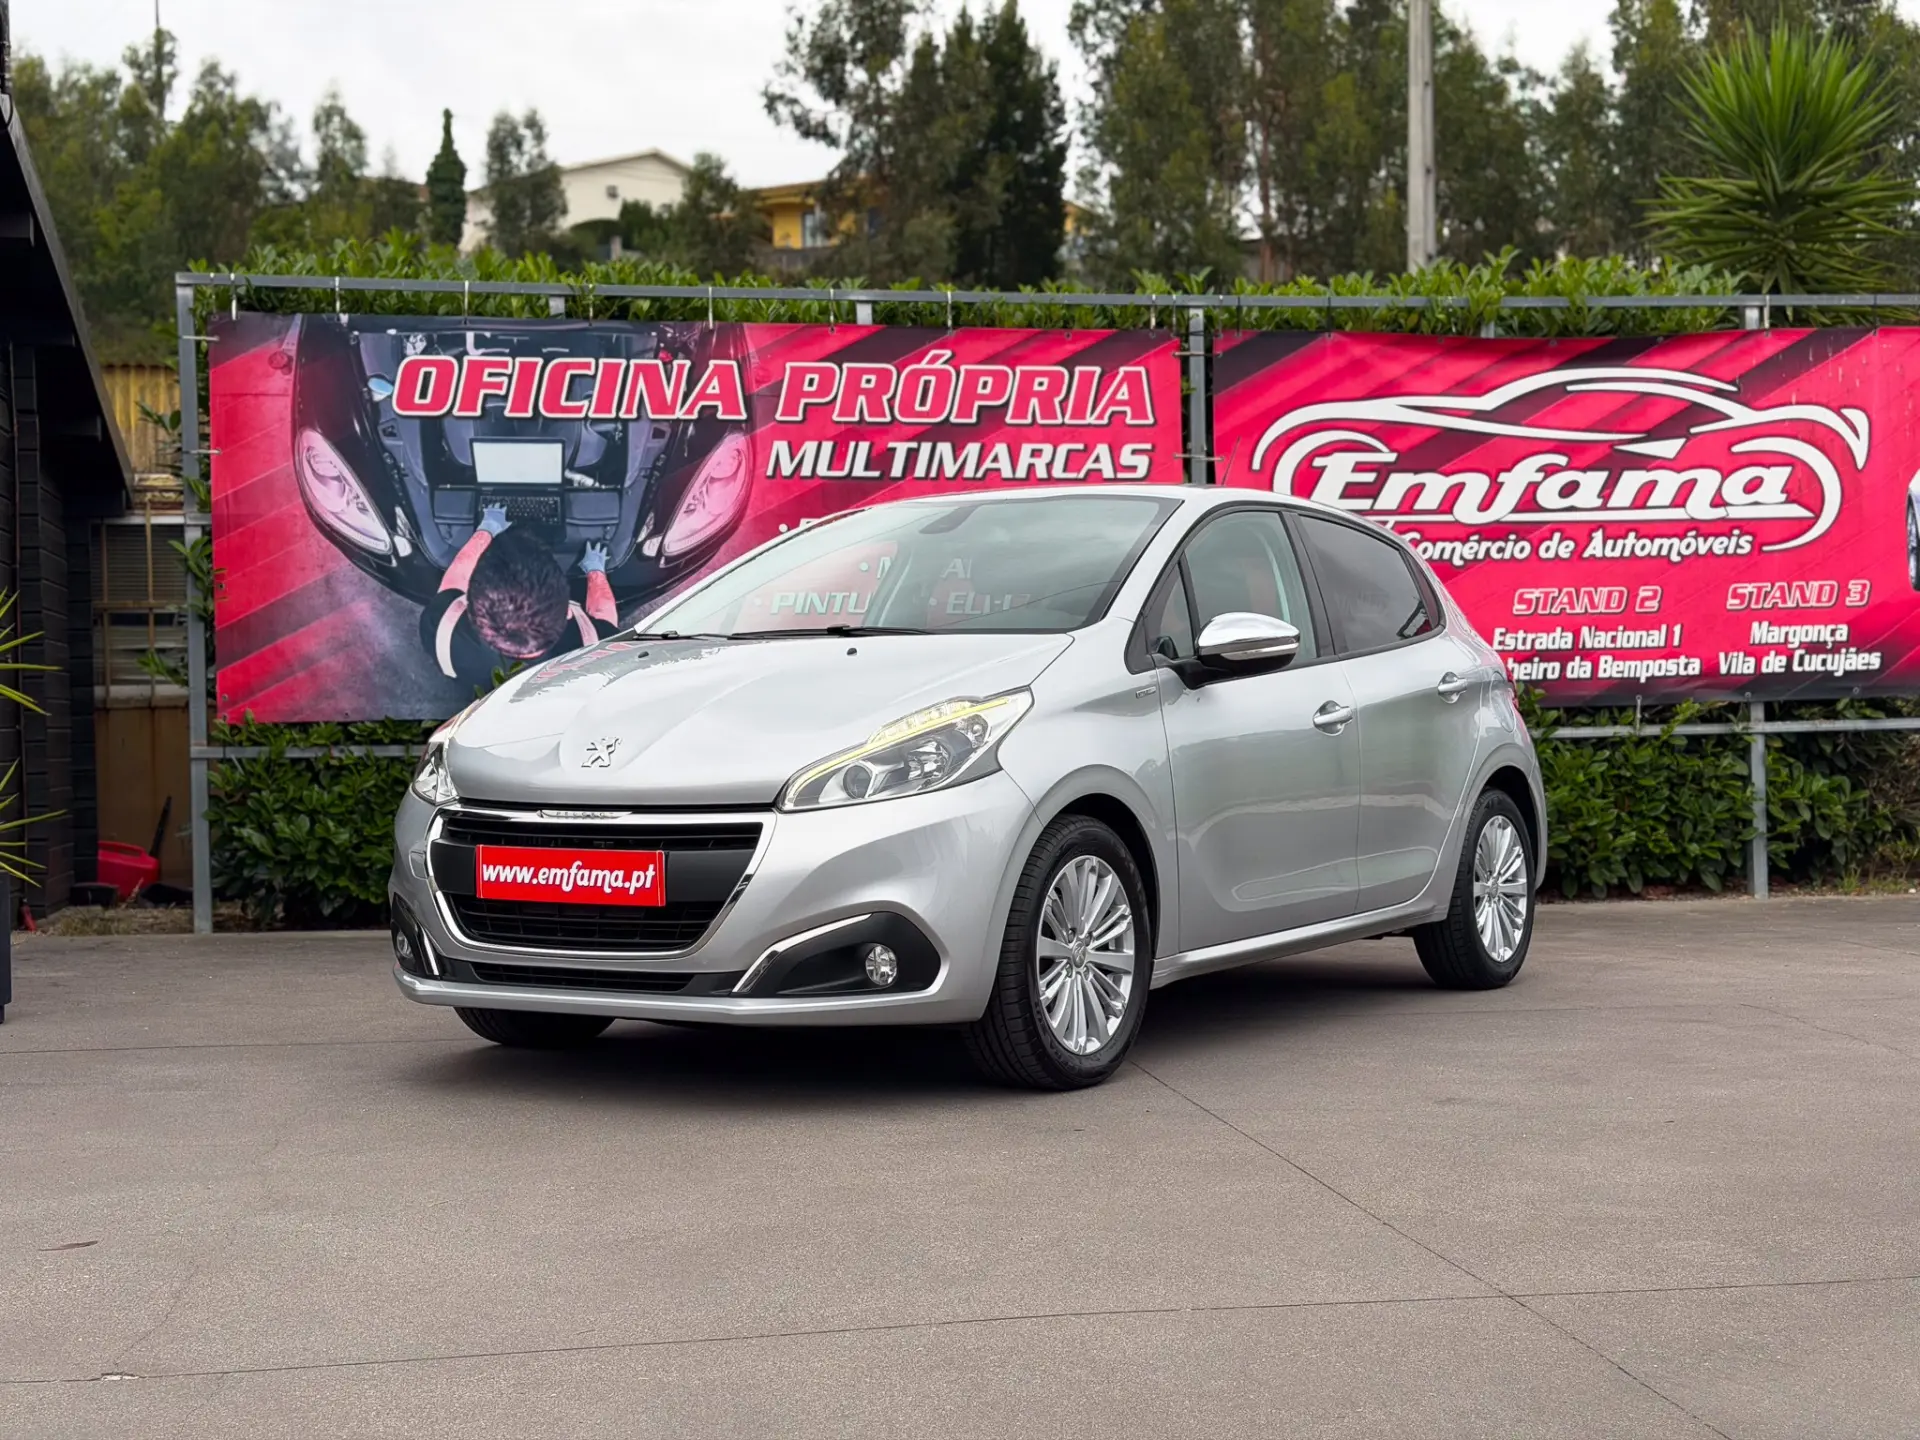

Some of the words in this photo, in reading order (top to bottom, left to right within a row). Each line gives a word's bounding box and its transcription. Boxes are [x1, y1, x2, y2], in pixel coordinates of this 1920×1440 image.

[392, 355, 747, 420] OFICINA
[775, 350, 1155, 425] PRÓPRIA
[766, 440, 1154, 479] MULTIMARCAS
[1310, 452, 1793, 525] Emfama
[1539, 531, 1576, 560] de
[1582, 528, 1754, 563] Automóveis
[770, 591, 871, 615] PINTU
[1513, 587, 1628, 615] STAND
[1635, 585, 1662, 613] 2
[1727, 581, 1839, 609] STAND
[1845, 579, 1870, 607] 3
[1492, 627, 1573, 651] Estrada
[1579, 625, 1667, 650] Nacional
[1672, 623, 1683, 647] 1
[1750, 620, 1848, 649] Margonça
[1507, 656, 1561, 681] heiro
[1566, 655, 1593, 679] da
[1597, 654, 1701, 683] Bemposta
[1718, 651, 1756, 675] Vila
[1761, 650, 1787, 673] de
[1792, 647, 1882, 677] Cucujães
[482, 860, 656, 895] www.emfama.pt
